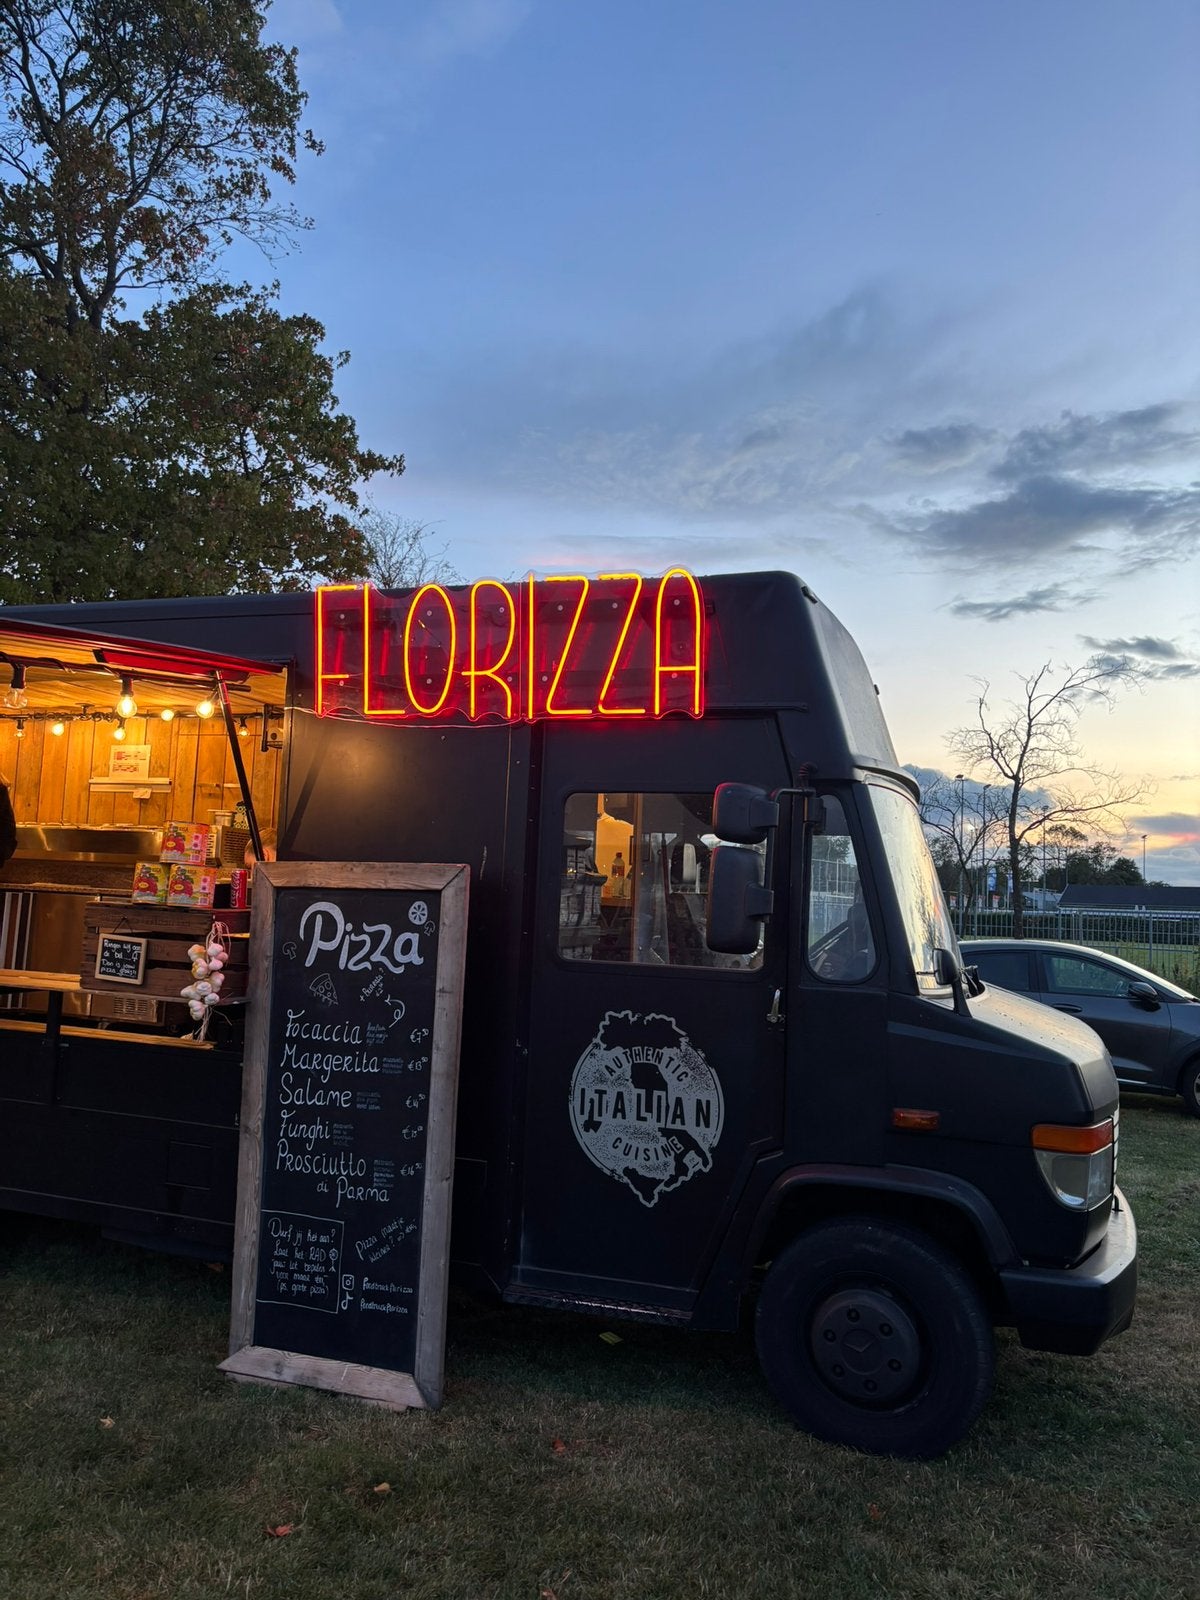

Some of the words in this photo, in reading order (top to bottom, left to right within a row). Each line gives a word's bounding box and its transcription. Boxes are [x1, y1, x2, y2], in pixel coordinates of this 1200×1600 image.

[317, 568, 701, 719] FLORIZZA
[300, 901, 424, 974] Pizza
[286, 1009, 362, 1045] Focaccia
[604, 1048, 689, 1082] AUTHENTIC
[279, 1072, 352, 1108] Salame
[579, 1087, 711, 1129] ITALIAN
[279, 1110, 331, 1151] Funghi
[612, 1137, 683, 1162] CUISINE
[316, 1180, 329, 1193] di
[268, 1217, 294, 1243] Durf
[307, 1229, 318, 1242] het
[355, 1235, 378, 1261] Pizza
[381, 1216, 405, 1239] maatje
[273, 1239, 289, 1257] Laat
[294, 1247, 304, 1260] het
[309, 1246, 326, 1262] RAD
[291, 1283, 307, 1297] grote
